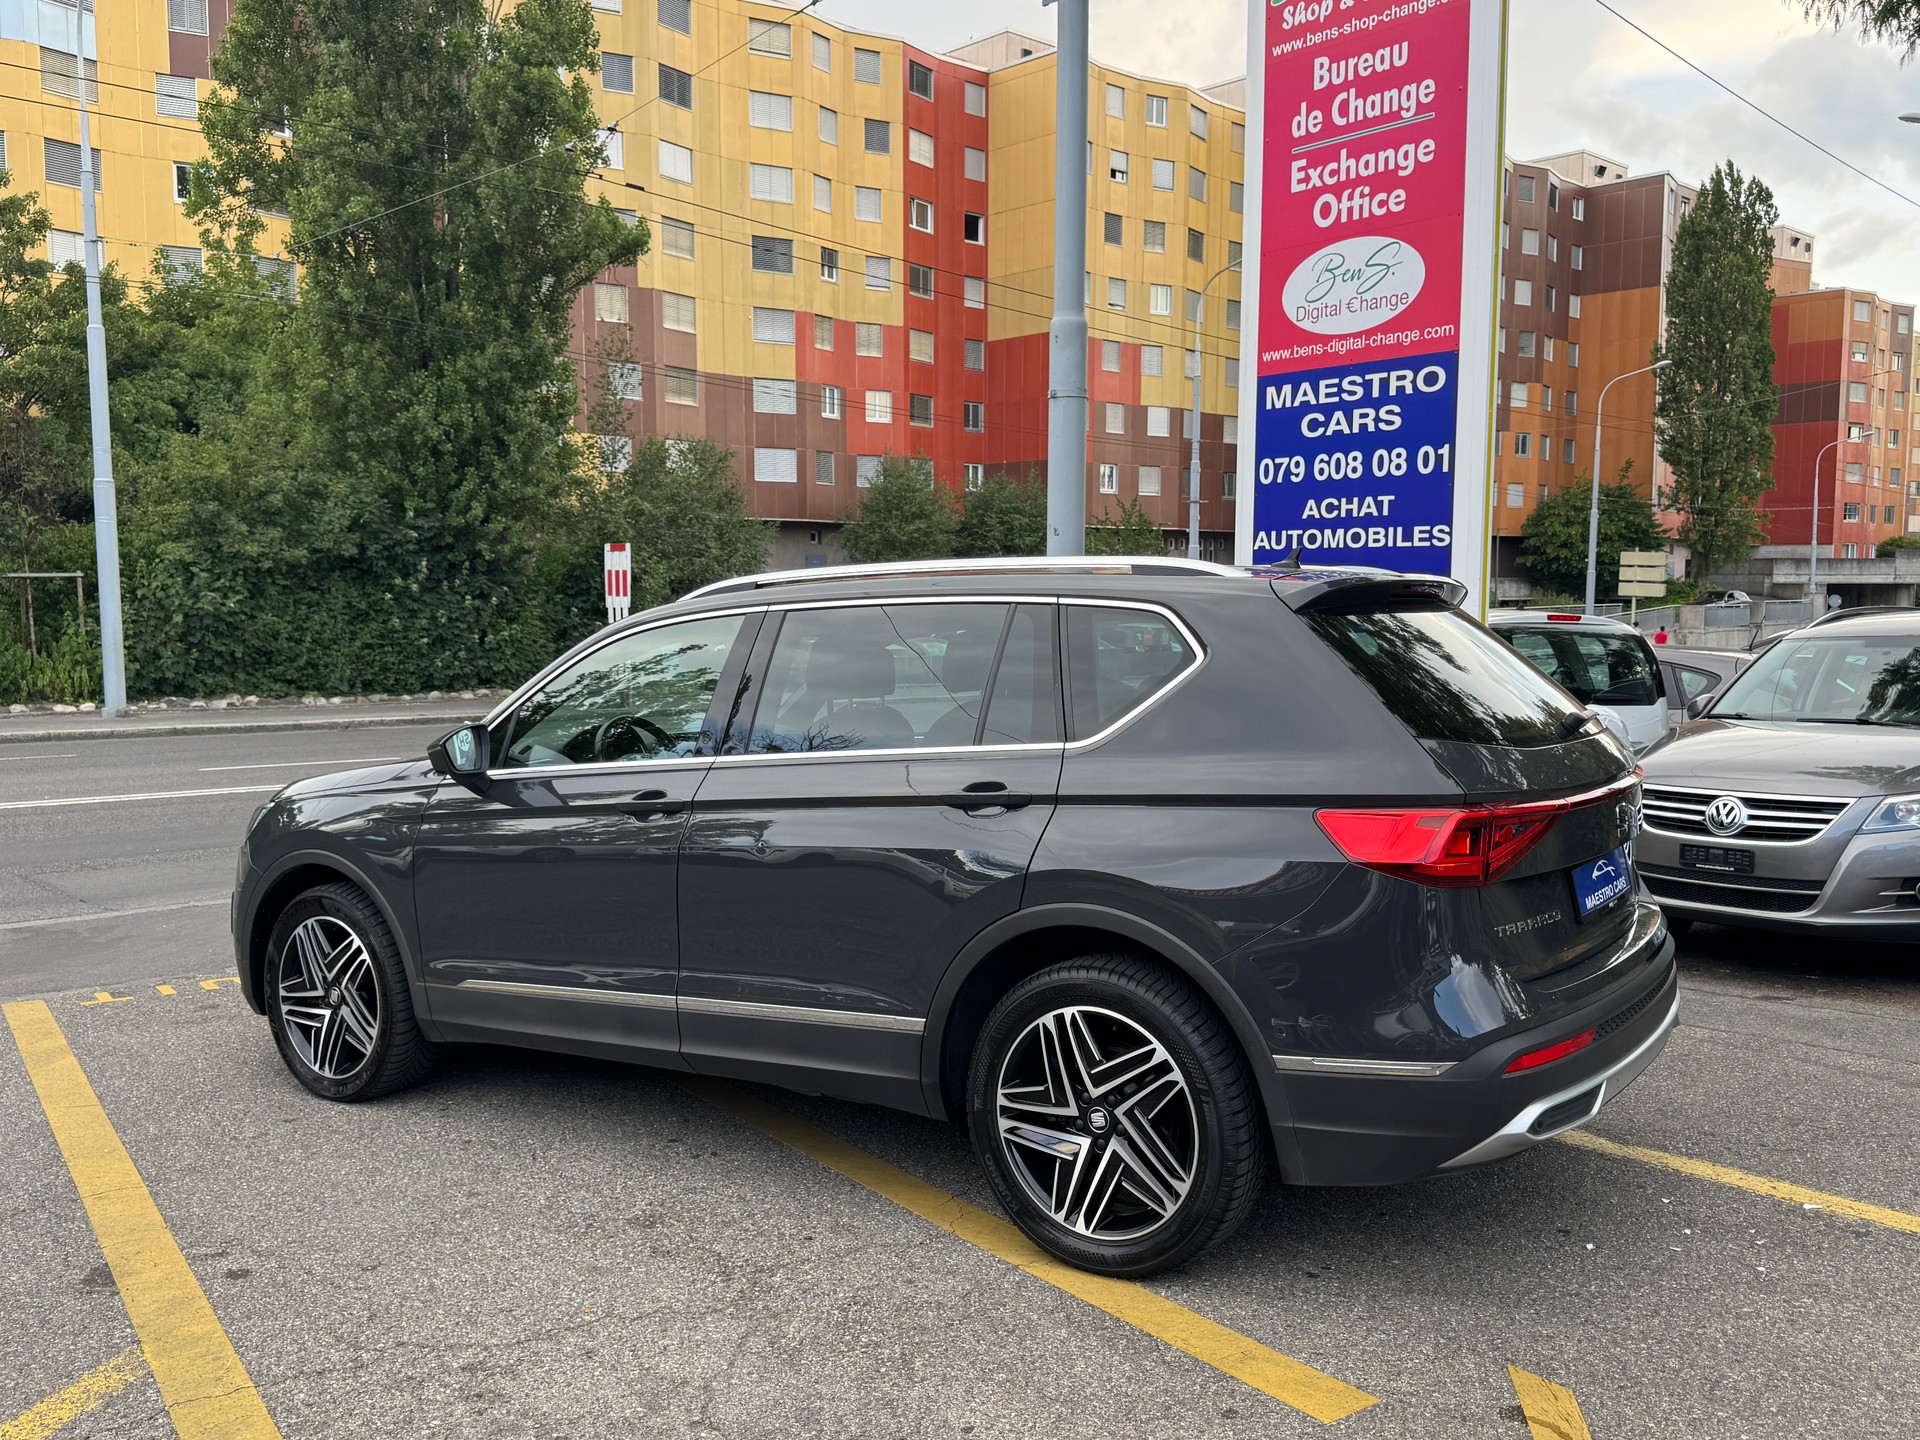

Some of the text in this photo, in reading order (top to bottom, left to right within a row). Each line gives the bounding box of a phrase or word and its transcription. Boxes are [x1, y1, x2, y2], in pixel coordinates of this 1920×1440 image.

[1281, 0, 1334, 30] Shop
[1313, 41, 1409, 91] Bureau
[1291, 78, 1436, 139] de Change
[1290, 138, 1436, 194] Exchange
[1312, 186, 1407, 228] Office
[1295, 299, 1342, 324] Digital
[1261, 324, 1455, 363] www.bens-digital-change.com
[1265, 365, 1447, 410] MAESTRO
[1300, 405, 1402, 438] CARS
[1258, 443, 1451, 485] 079 608 08 01
[1301, 495, 1396, 520] ACHAT
[1253, 524, 1451, 550] AUTOMOBILES
[1585, 884, 1614, 910] MAESTRO
[1613, 875, 1627, 893] CARS
